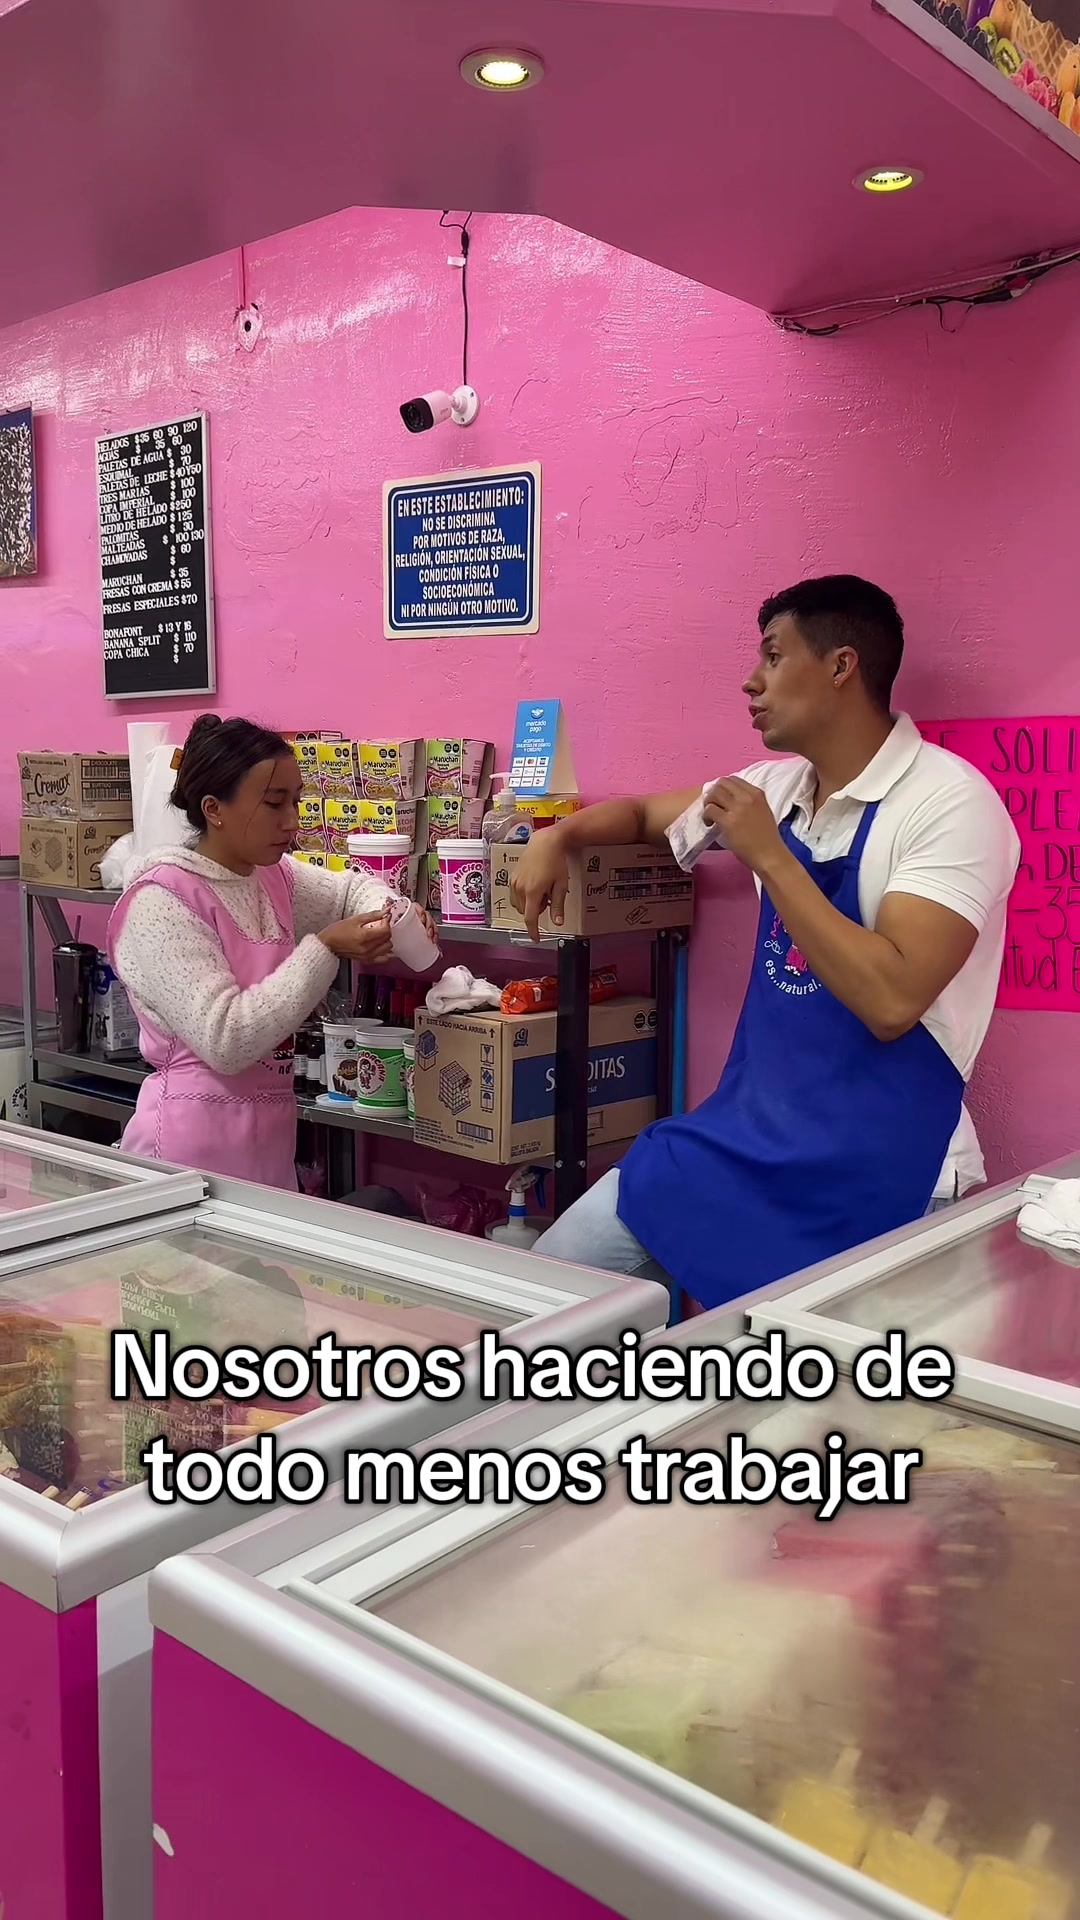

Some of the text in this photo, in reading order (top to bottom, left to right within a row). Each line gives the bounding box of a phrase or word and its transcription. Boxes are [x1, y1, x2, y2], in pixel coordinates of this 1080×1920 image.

[98, 438, 129, 452] HELADOS
[153, 429, 163, 440] 60
[182, 421, 197, 433] 120
[98, 435, 182, 462] AGUAS $ 35 60
[98, 444, 192, 473] PALETAS DE AGUA $ 30
[99, 455, 191, 484] ESQUIMAL $ 70
[99, 480, 129, 494] PALETAS
[129, 476, 140, 488] DE
[144, 470, 168, 484] LECHE
[99, 477, 195, 504] TRES MARIAS $ 100
[99, 487, 196, 514] COPA IMPERIAL $ 100
[397, 486, 524, 518] EN ESTE ESTABLECIMIENTO:
[100, 513, 120, 524] LITRO
[123, 510, 134, 520] DE
[136, 503, 168, 517] HELADO
[422, 511, 496, 532] NO SE DISCRIMINA
[100, 523, 124, 535] MEDIO
[125, 520, 136, 531] DE
[137, 515, 168, 529] HELADO
[101, 520, 194, 545] PALOMITAS $ 30
[101, 529, 204, 555] MALTEADAS $ 100 130
[413, 528, 505, 549] POR MOTIVOS DE RAZA,
[101, 543, 192, 567] CHAMOYADAS $ 60
[395, 543, 525, 568] RELIGIÓN, ORIENTACIÓN SEXUAL,
[102, 574, 143, 588] MARUCHAN
[418, 563, 499, 583] CONDICIÓN FÍSICA O
[102, 588, 130, 600] FRESAS
[131, 584, 147, 596] CON
[147, 580, 173, 594] CREMA
[422, 580, 495, 600] SOCIOECONÓMICA
[103, 602, 131, 615] FRESAS
[134, 596, 180, 611] ESPECIALES
[401, 598, 519, 618] NI POR NINGÚN OTRO MOTIVO.
[104, 626, 143, 639] BONAFONT
[175, 621, 182, 632] Y
[184, 621, 192, 631] 16
[104, 631, 197, 650] BANANA SPLIT $ 110
[103, 642, 194, 660] COPA CHICA $ 70
[368, 761, 396, 769] Maruchan
[34, 773, 70, 797] Cremax
